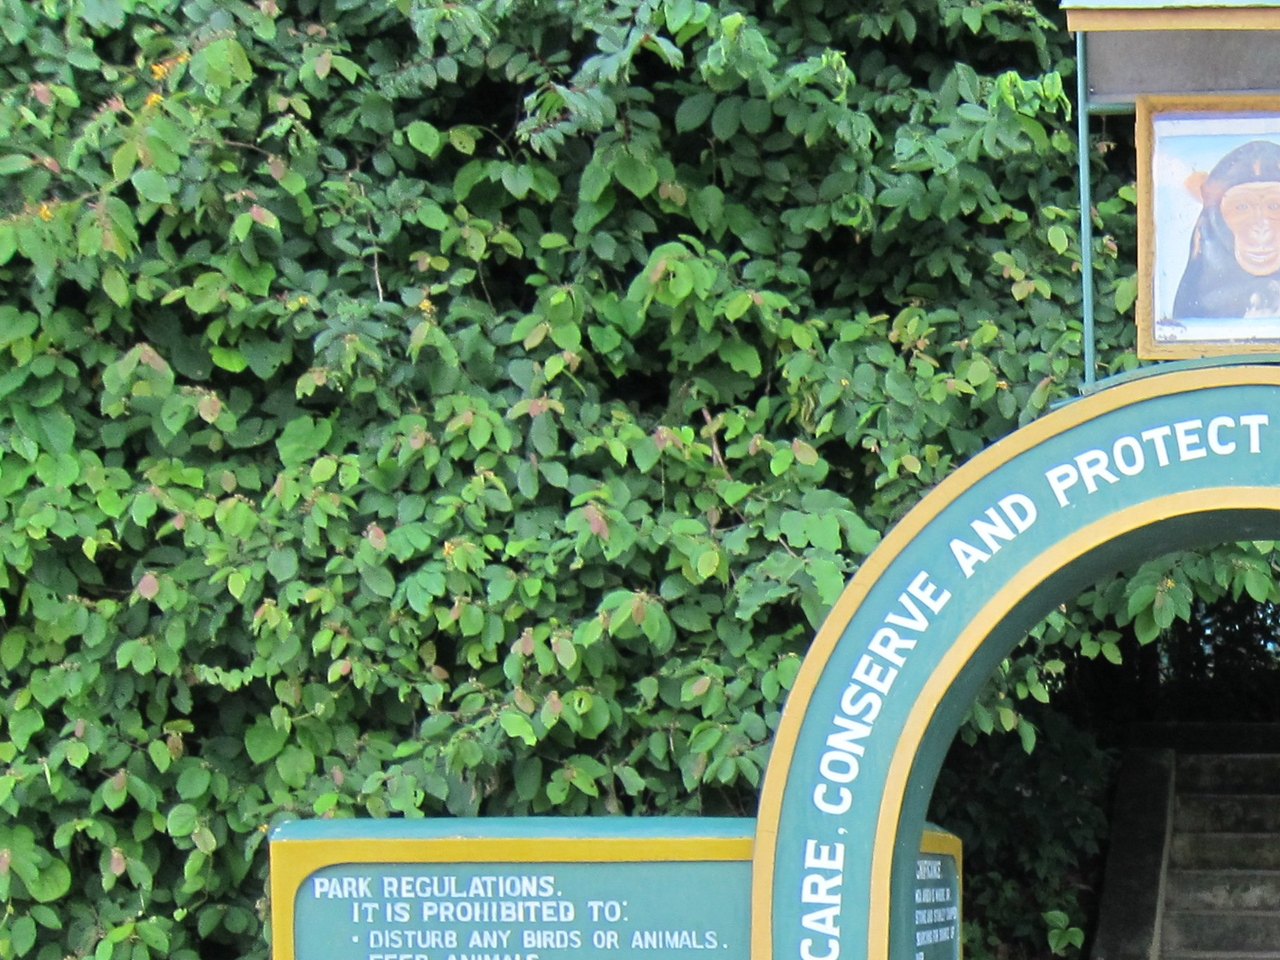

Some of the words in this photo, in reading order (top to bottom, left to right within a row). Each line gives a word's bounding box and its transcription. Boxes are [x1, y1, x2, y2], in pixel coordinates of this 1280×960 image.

[814, 571, 951, 815] CONSERVE
[950, 494, 1037, 579] AND
[1045, 415, 1268, 507] PROTECT
[314, 876, 372, 899] PARK
[382, 876, 562, 899] REGULATIONS.
[353, 901, 380, 923] IT
[386, 901, 411, 923] IS
[422, 901, 575, 923] PROHIBITED
[587, 901, 628, 923] TO:
[369, 930, 458, 950] DISTURB
[468, 930, 511, 950] ANY
[523, 930, 582, 950] BIRDS
[593, 930, 620, 950] OR
[631, 930, 728, 950] ANIMALS.
